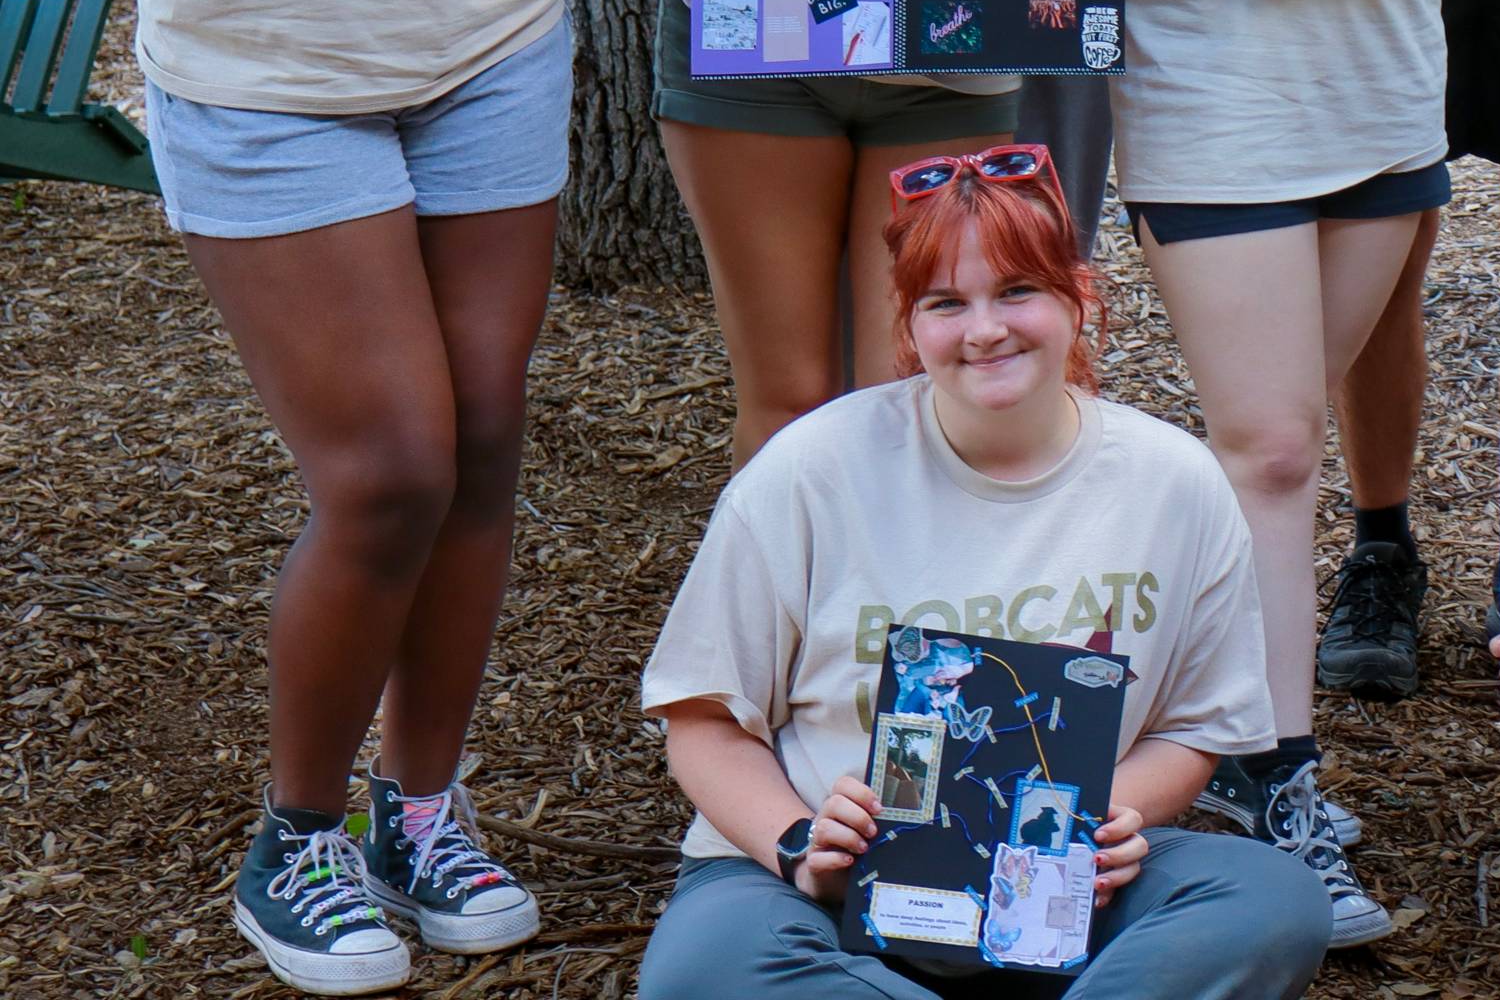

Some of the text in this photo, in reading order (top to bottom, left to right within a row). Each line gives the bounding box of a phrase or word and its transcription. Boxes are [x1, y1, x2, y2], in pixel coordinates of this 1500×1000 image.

[929, 4, 973, 44] breathe
[1087, 23, 1115, 32] TODAY
[856, 571, 1160, 664] BOBCATS
[908, 899, 944, 909] PASSION
